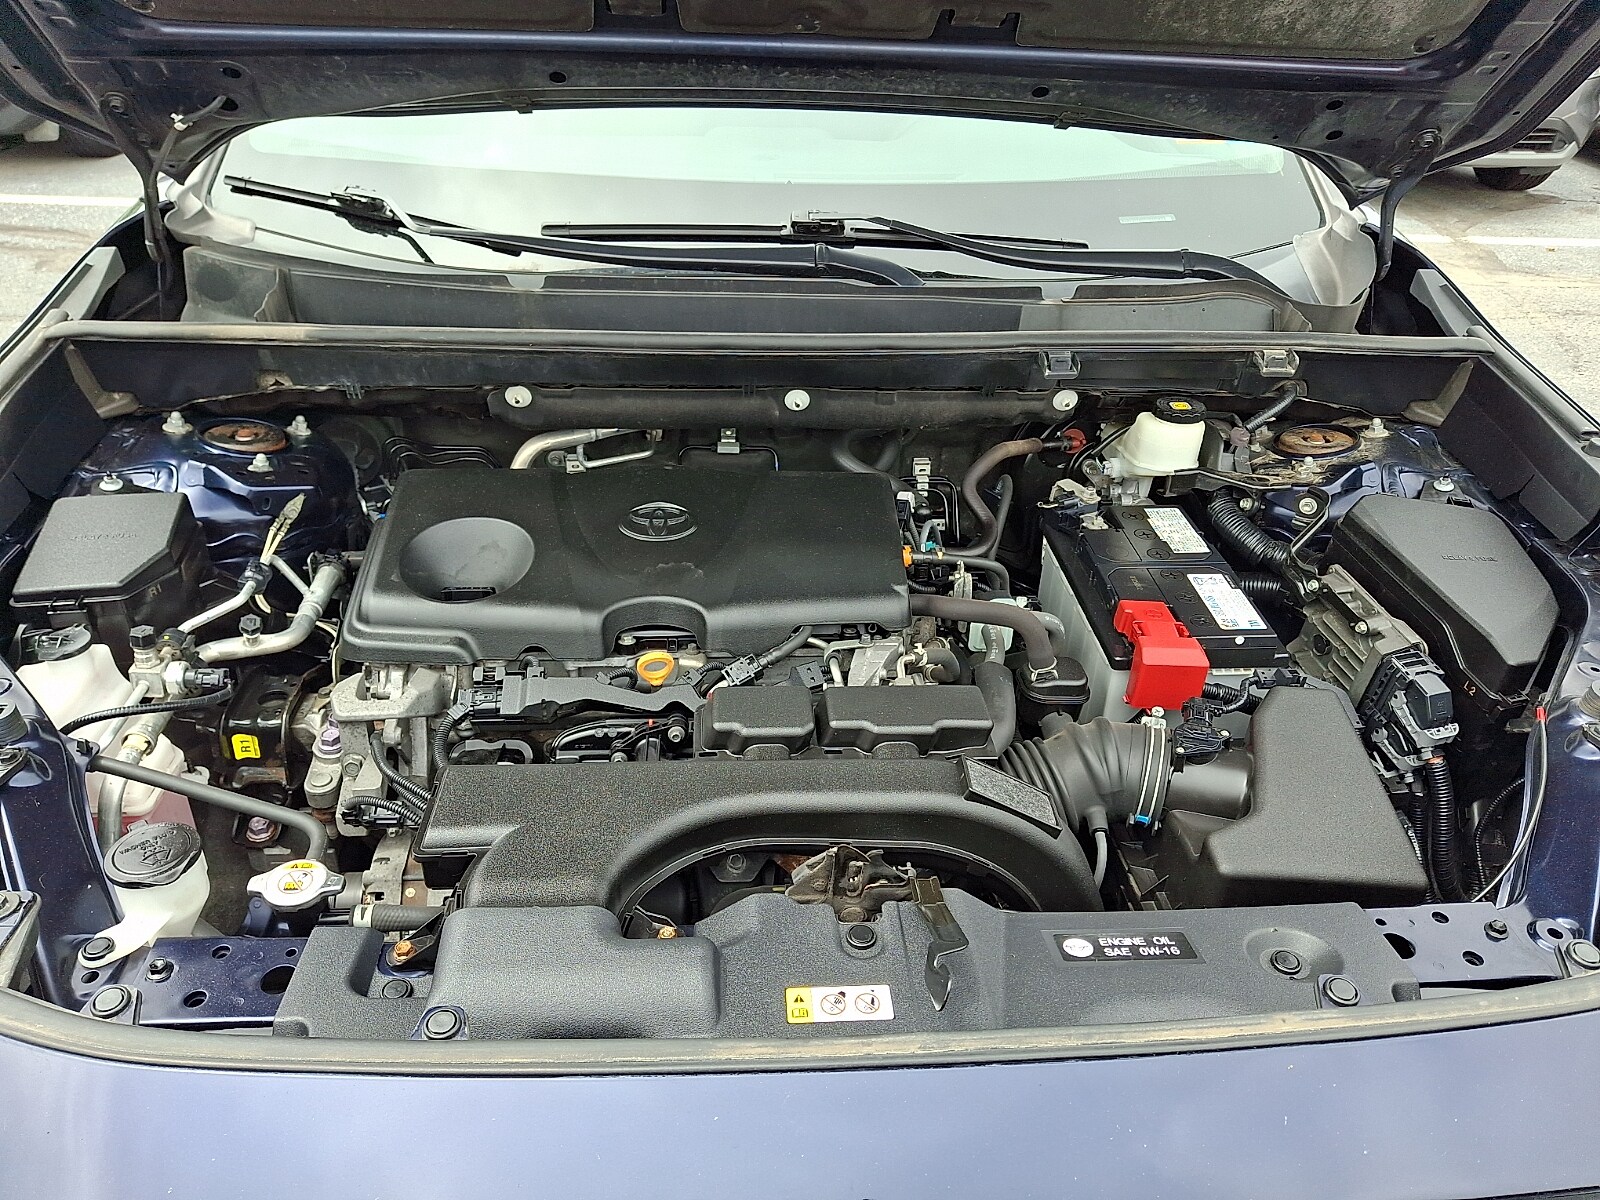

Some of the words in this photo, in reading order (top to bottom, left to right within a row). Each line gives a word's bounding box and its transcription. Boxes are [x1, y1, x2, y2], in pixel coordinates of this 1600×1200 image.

[149, 583, 162, 598] R1
[1463, 680, 1476, 697] L2
[239, 740, 252, 753] R1
[1098, 937, 1147, 946] ENGINE
[1152, 936, 1176, 946] OIL
[1103, 947, 1133, 957] SAE
[1138, 946, 1181, 956] 0W-16
